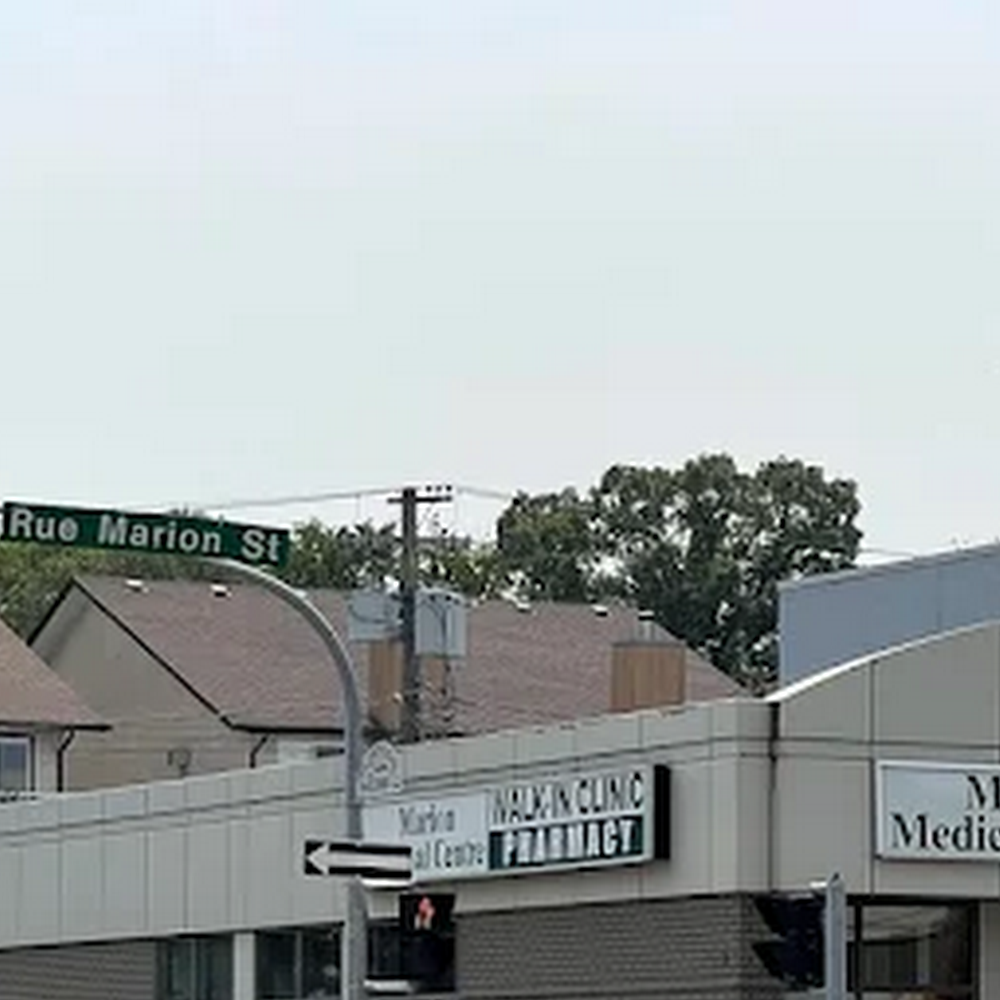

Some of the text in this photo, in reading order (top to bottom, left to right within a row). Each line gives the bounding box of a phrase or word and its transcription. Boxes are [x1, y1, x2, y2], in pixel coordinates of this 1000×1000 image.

[9, 507, 281, 562] Rue Marion St
[576, 771, 644, 815] CLINIC
[502, 818, 635, 868] PHARMACY
